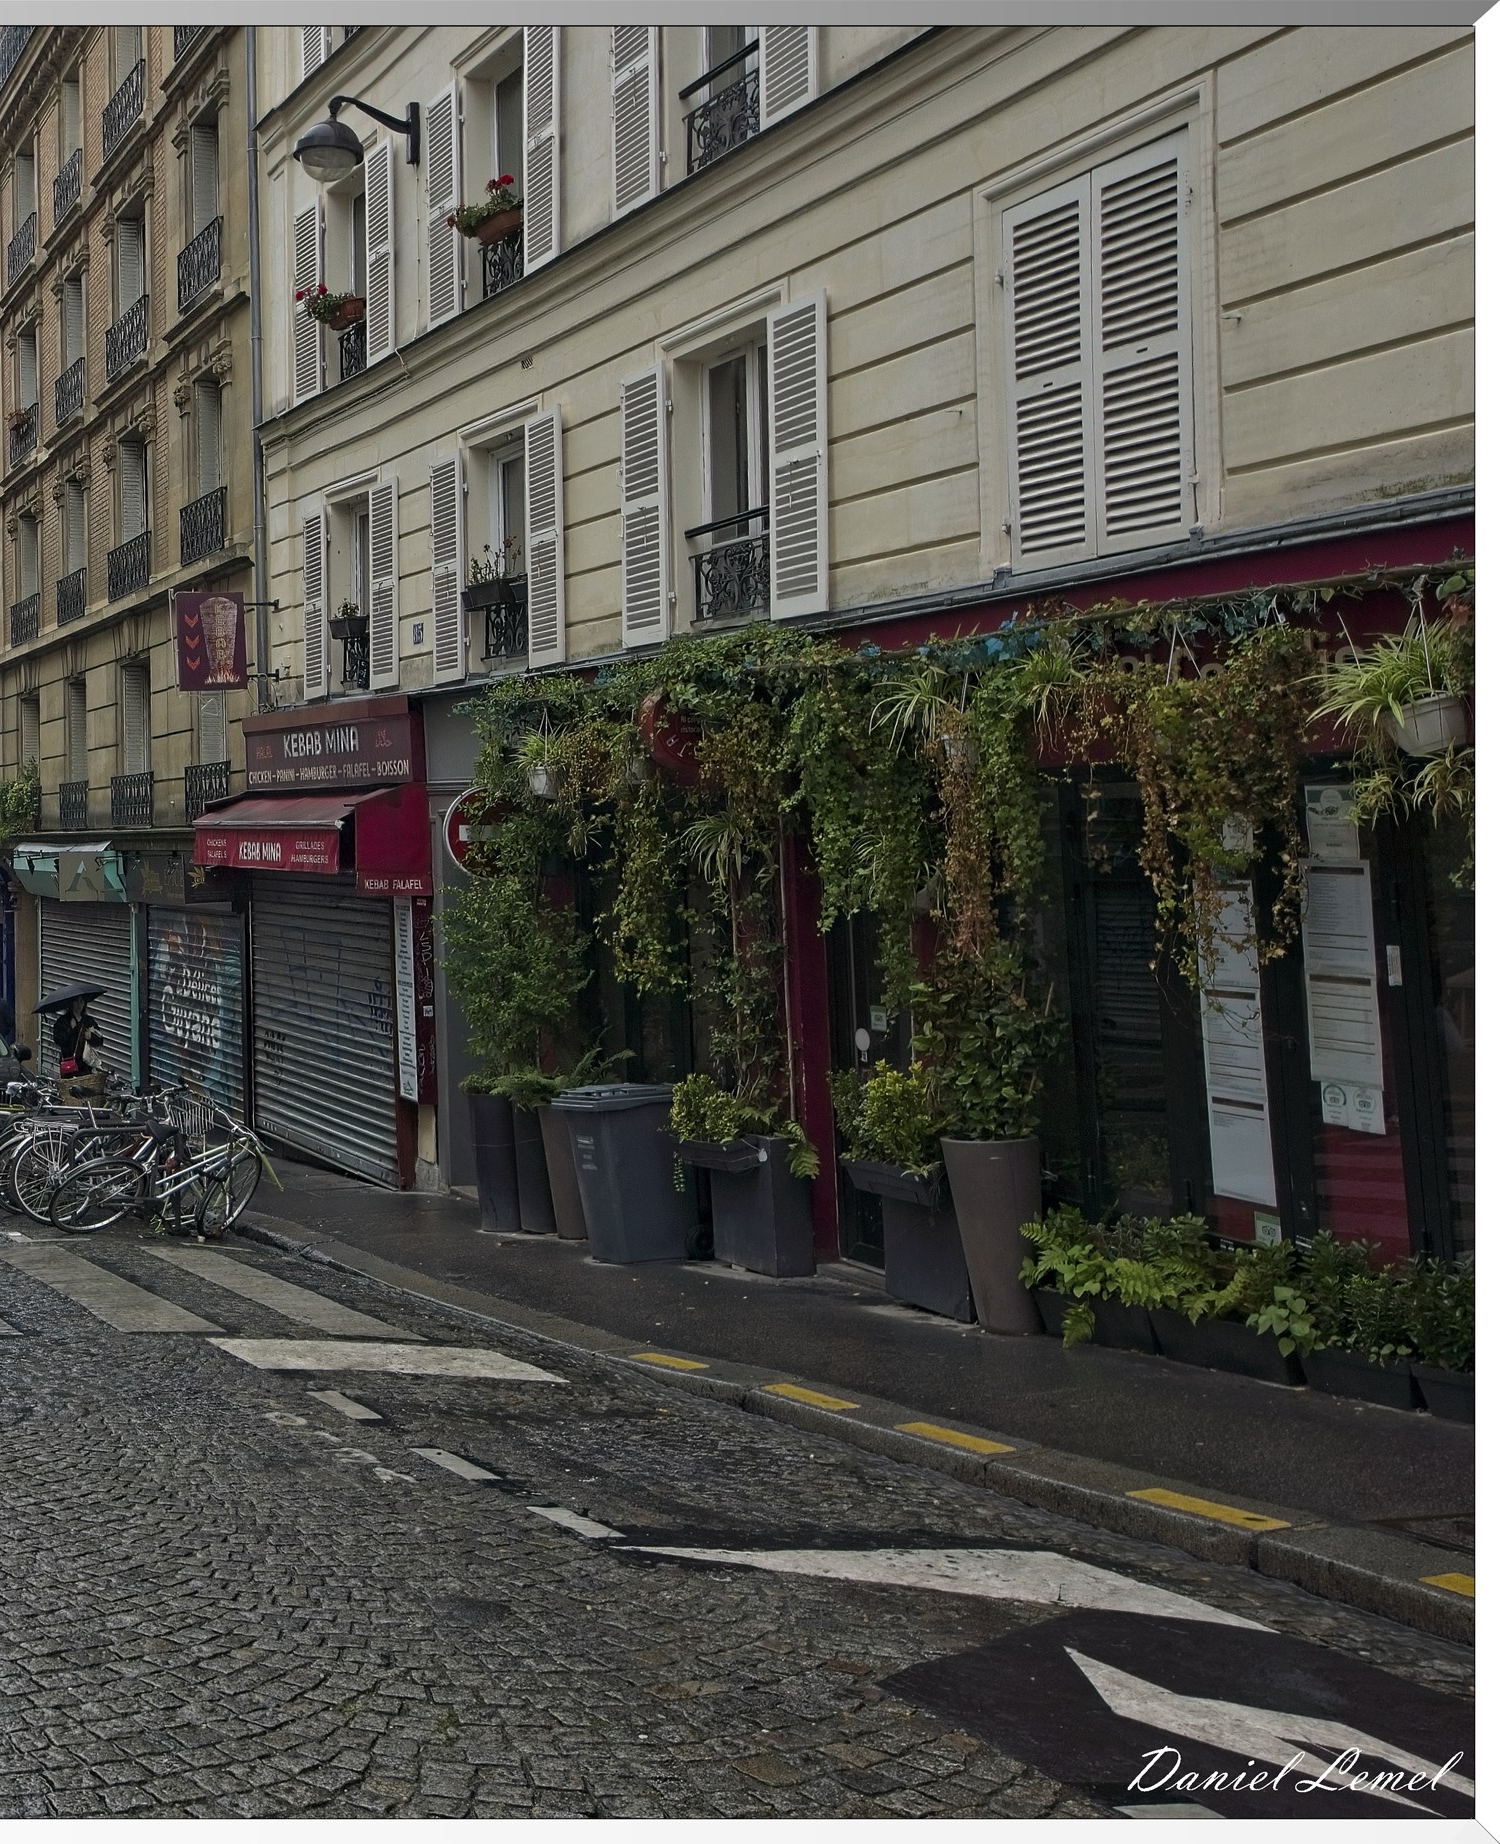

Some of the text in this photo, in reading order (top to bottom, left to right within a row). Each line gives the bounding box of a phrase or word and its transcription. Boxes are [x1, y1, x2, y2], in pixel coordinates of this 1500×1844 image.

[283, 725, 360, 759] KEBAB MINA
[248, 759, 410, 785] CHICKEN PANINI HAMBURGER FALAFEL BOISSON
[238, 841, 261, 861] KEBAB
[262, 841, 282, 862] MINA
[295, 840, 325, 851] GRILLADES
[290, 854, 329, 864] HAMBURGERS
[364, 879, 423, 890] KEBAB FALAFEL
